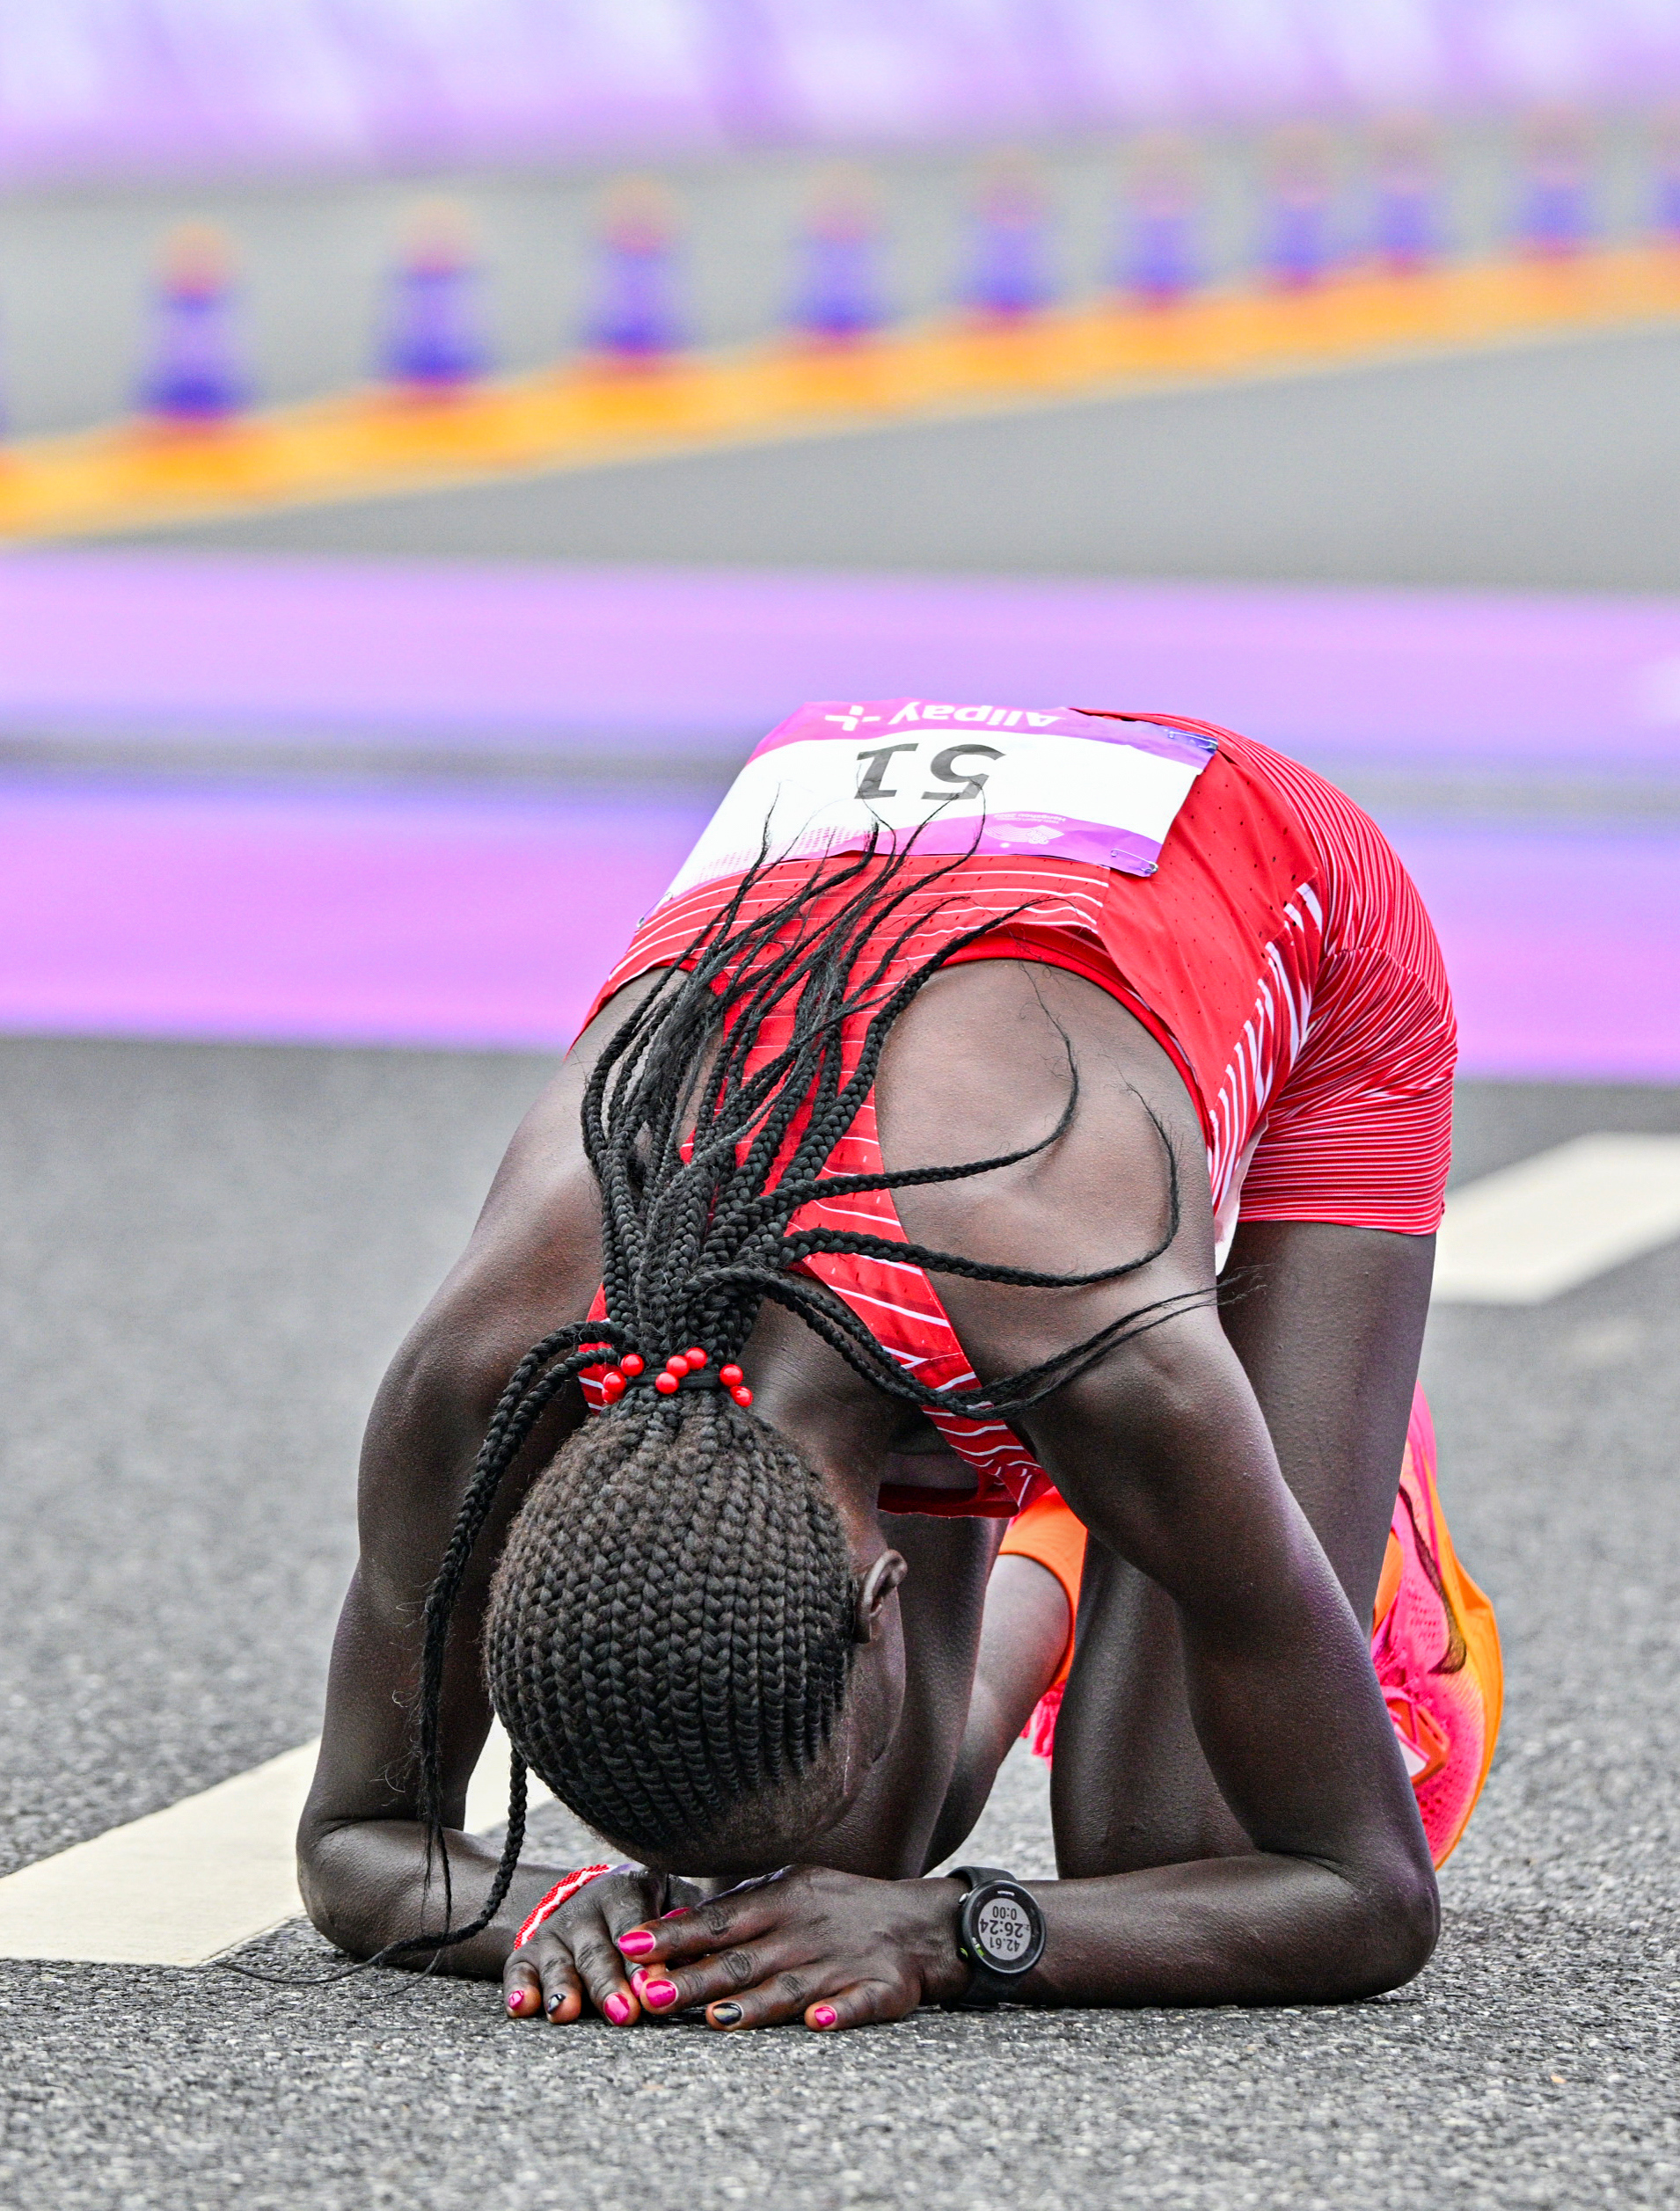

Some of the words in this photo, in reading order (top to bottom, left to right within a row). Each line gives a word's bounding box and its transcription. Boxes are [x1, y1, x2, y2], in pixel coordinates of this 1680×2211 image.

[854, 743, 1005, 800] 51
[1018, 814, 1066, 822] Hangzhou
[992, 1906, 1017, 1920] 0:00
[979, 1918, 1023, 1938] 26:24
[990, 1937, 1020, 1952] 42.61
